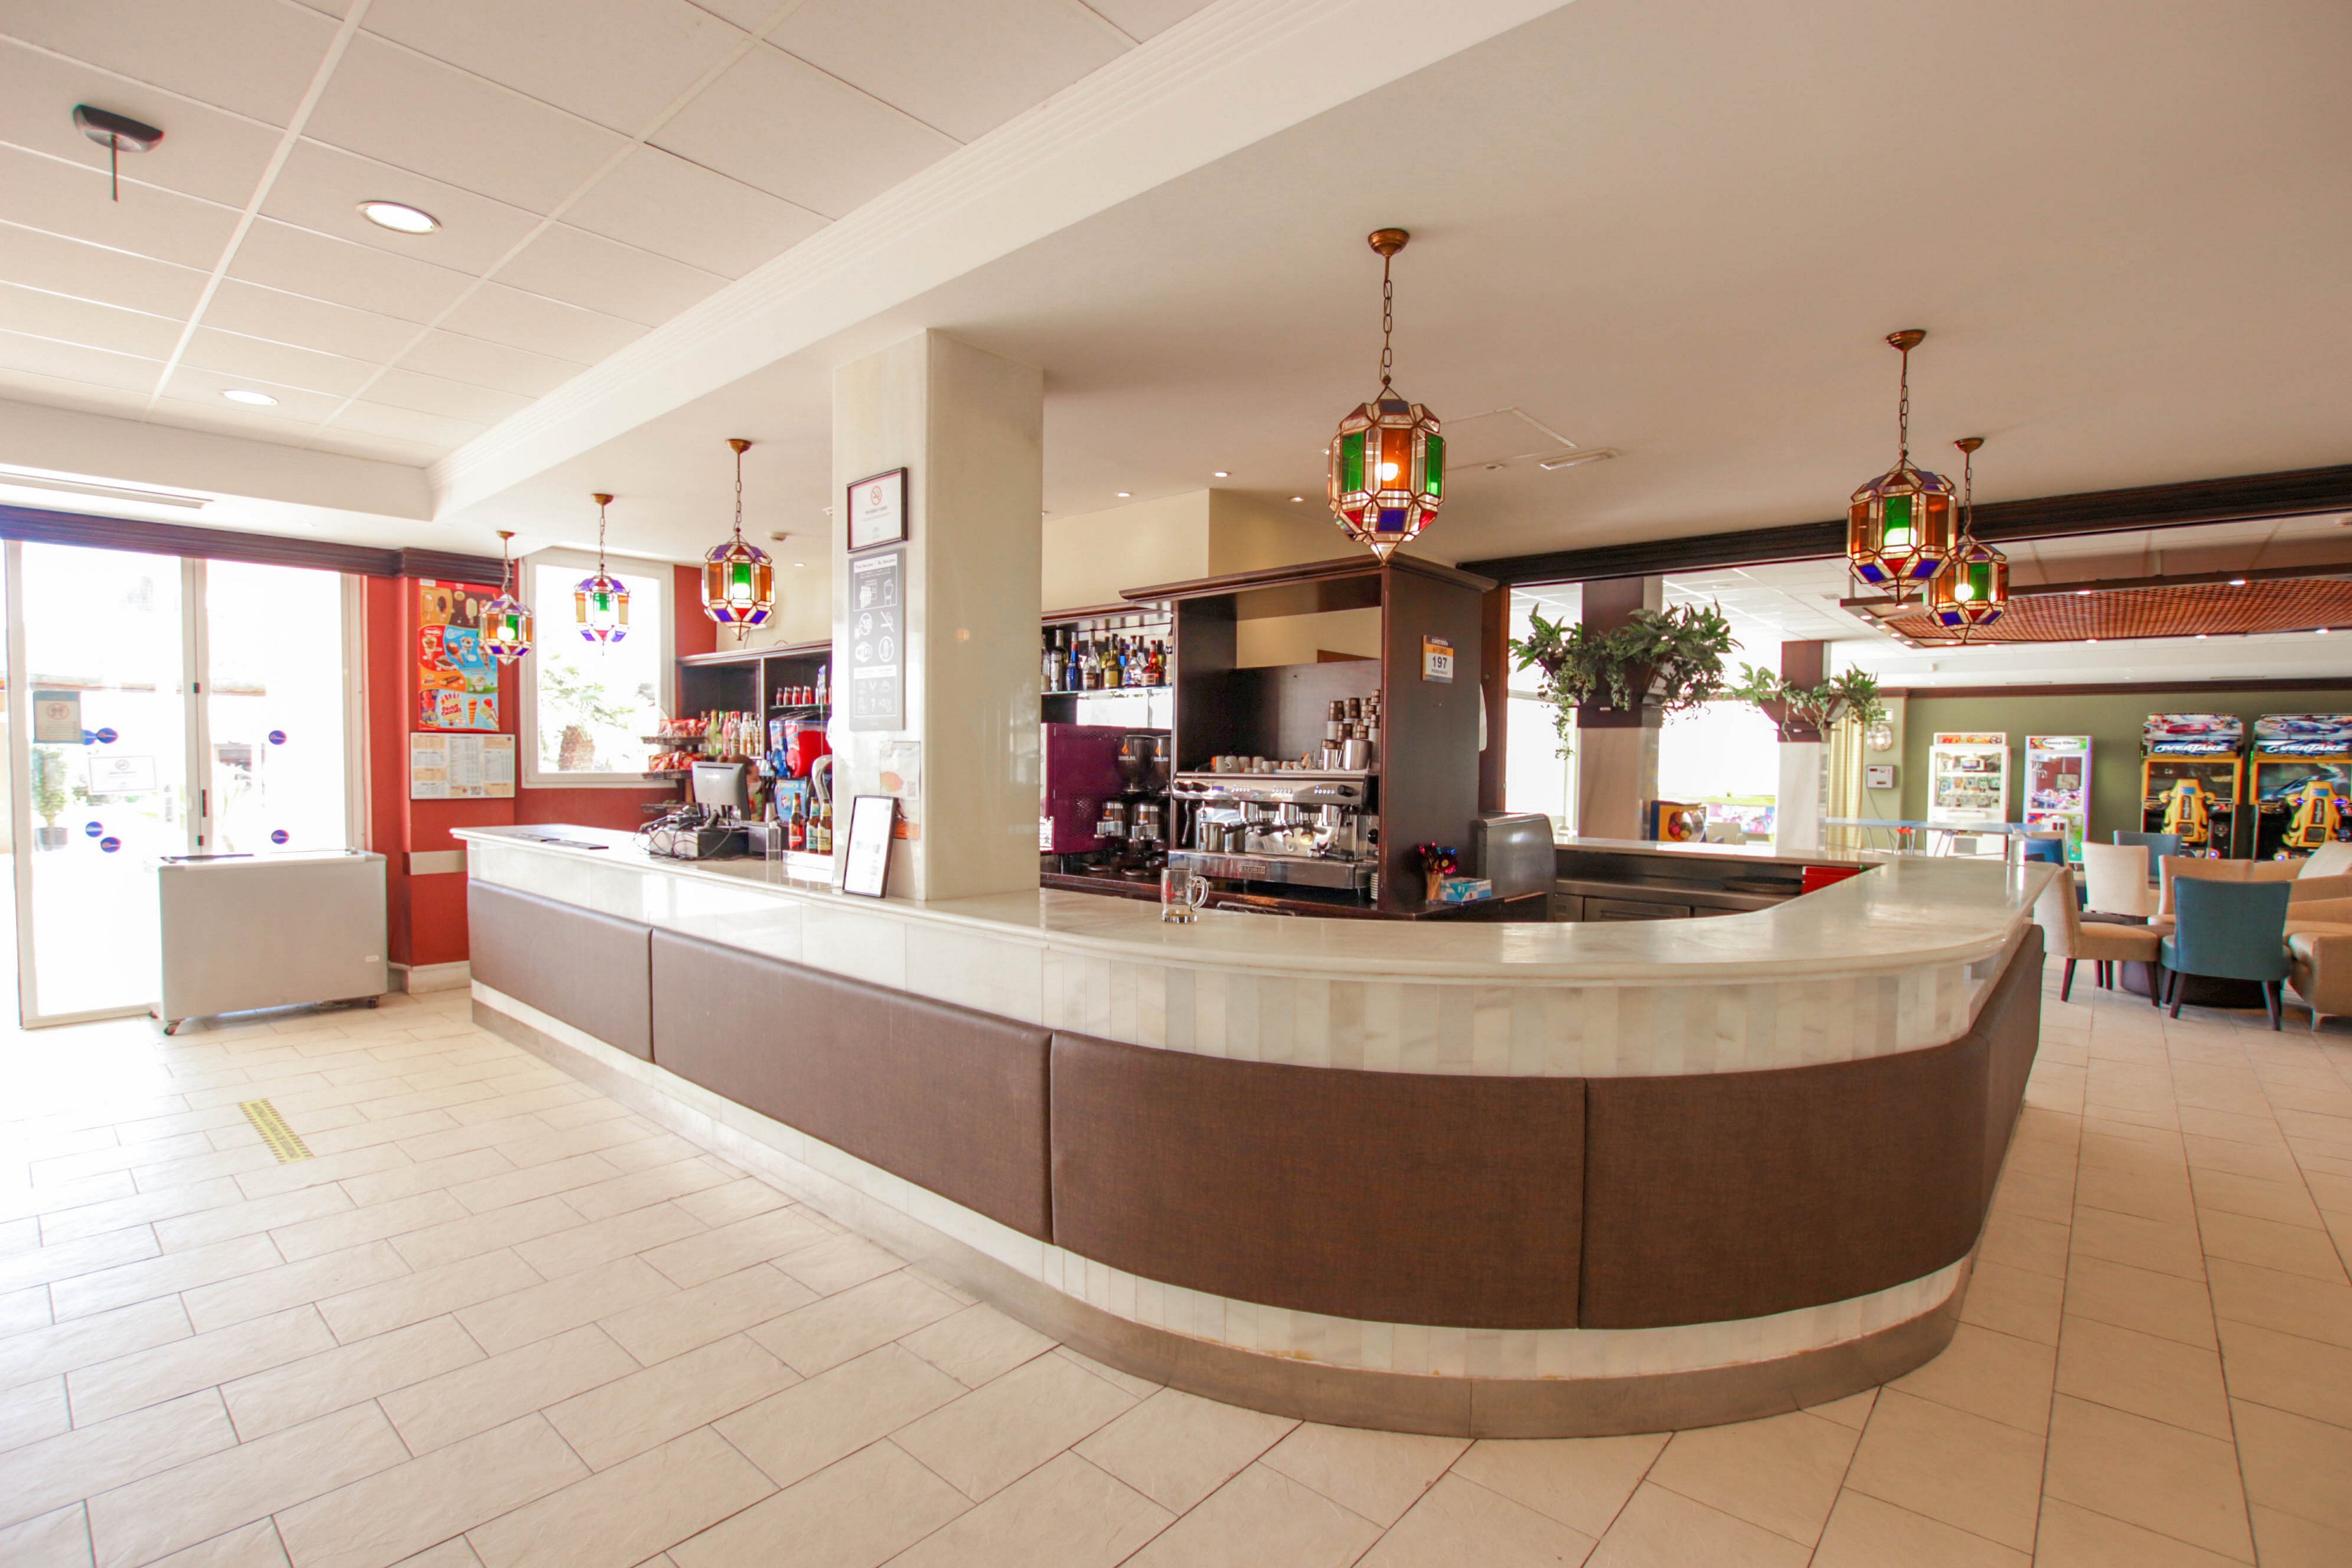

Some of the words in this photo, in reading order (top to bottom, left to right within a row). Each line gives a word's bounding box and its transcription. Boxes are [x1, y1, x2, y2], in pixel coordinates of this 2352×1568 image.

[1433, 655, 1447, 668] 197
[2154, 744, 2228, 753] OVERTAKE
[2266, 744, 2346, 753] OVERTAKE
